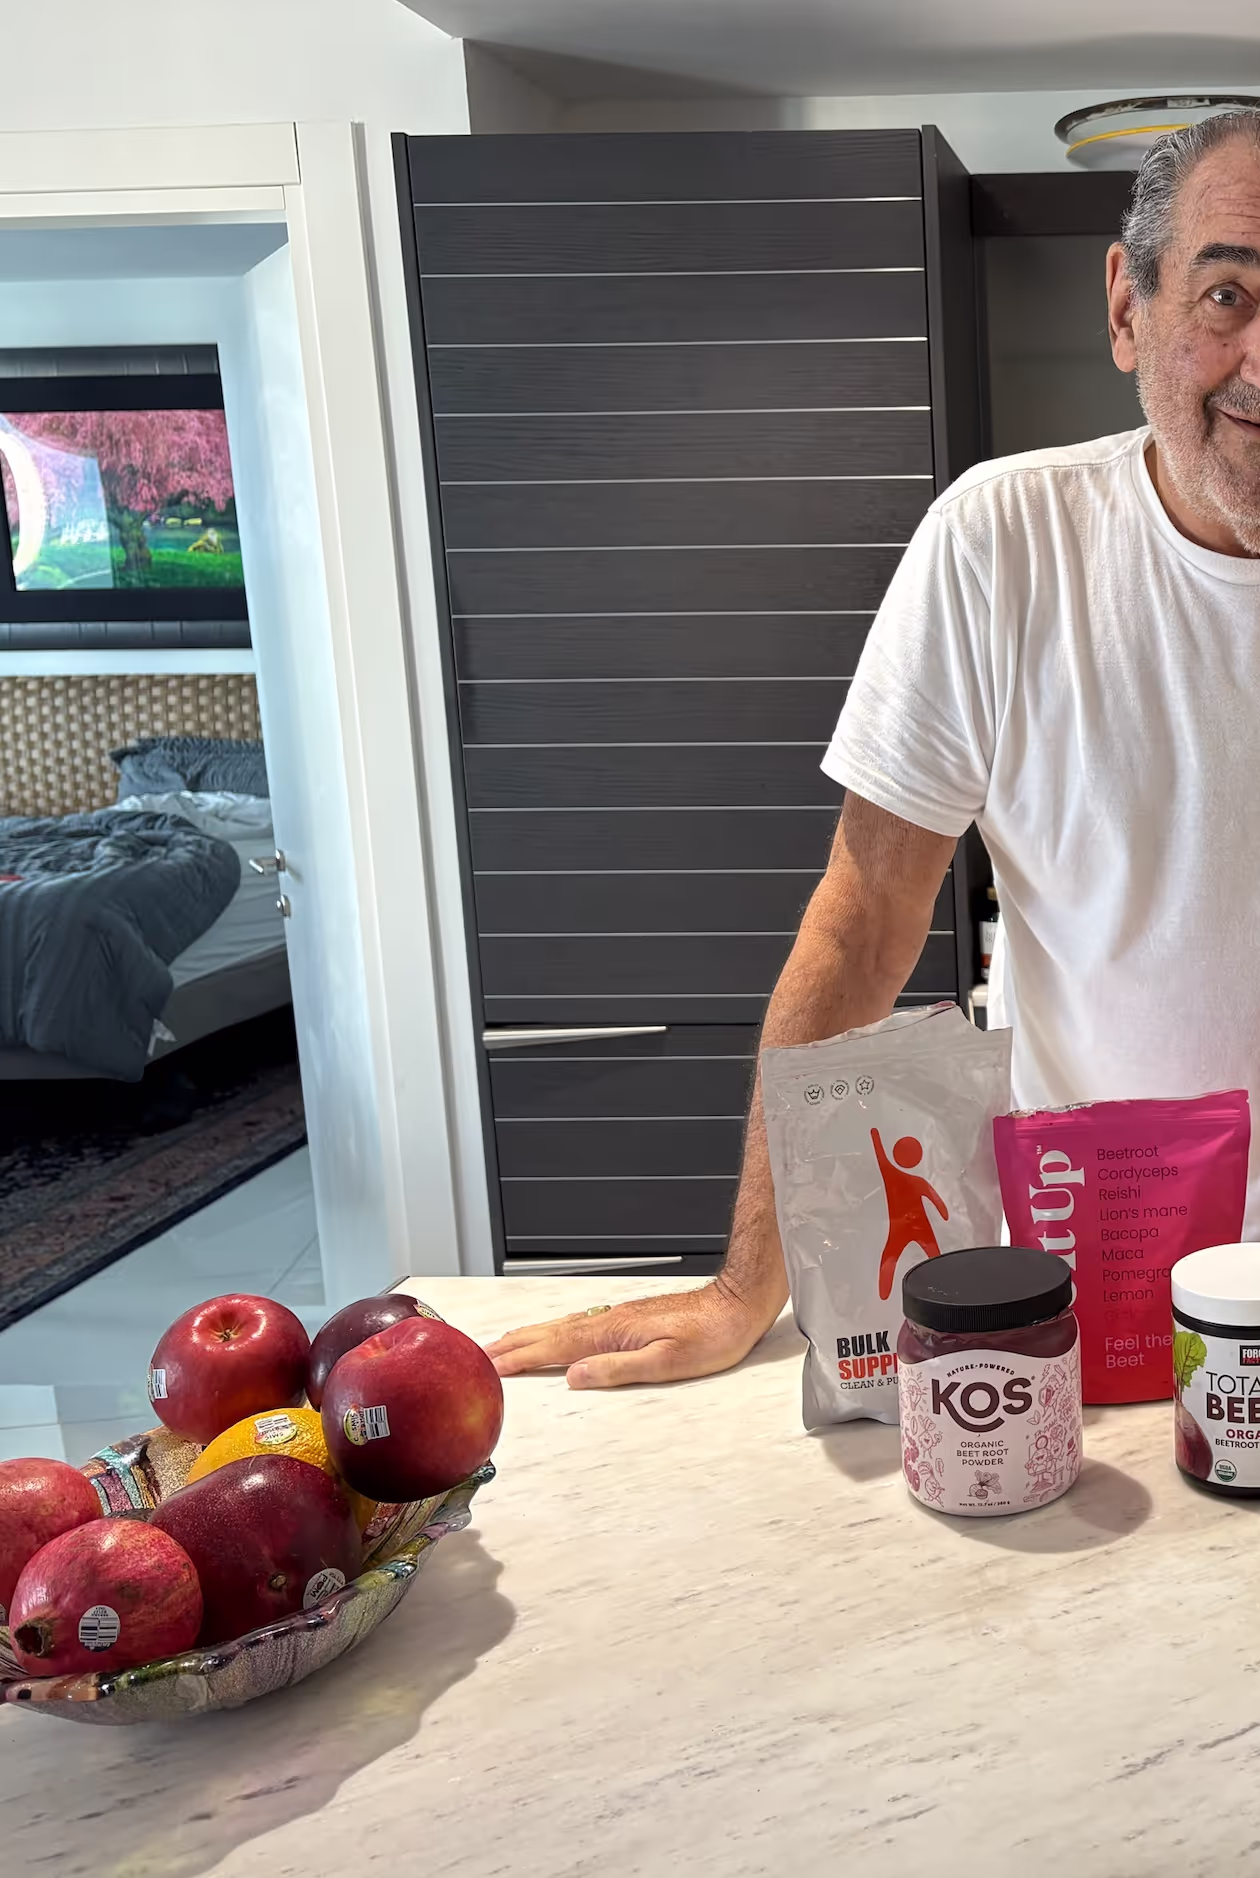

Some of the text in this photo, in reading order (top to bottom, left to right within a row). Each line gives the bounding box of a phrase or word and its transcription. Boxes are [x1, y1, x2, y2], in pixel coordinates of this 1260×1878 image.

[1097, 1145, 1159, 1161] Beetroot
[1098, 1165, 1178, 1182] Cordyceps
[1099, 1185, 1141, 1201] Reishi
[1100, 1205, 1188, 1221] Lion's mane
[1101, 1227, 1159, 1243] Bacopa
[1102, 1248, 1144, 1261] Maca
[1104, 1288, 1155, 1302] Lemon
[836, 1330, 891, 1359] BULK
[1105, 1333, 1173, 1353] Feel the
[1106, 1352, 1145, 1369] Beet
[840, 1379, 874, 1390] CLEAN
[877, 1378, 884, 1387] &
[931, 1378, 1032, 1433] KOS
[960, 1440, 1004, 1449] ORGANIC
[1215, 1438, 1260, 1449] BEETROOT
[956, 1448, 1009, 1458] BEET ROOT
[961, 1458, 1004, 1466] POWDER
